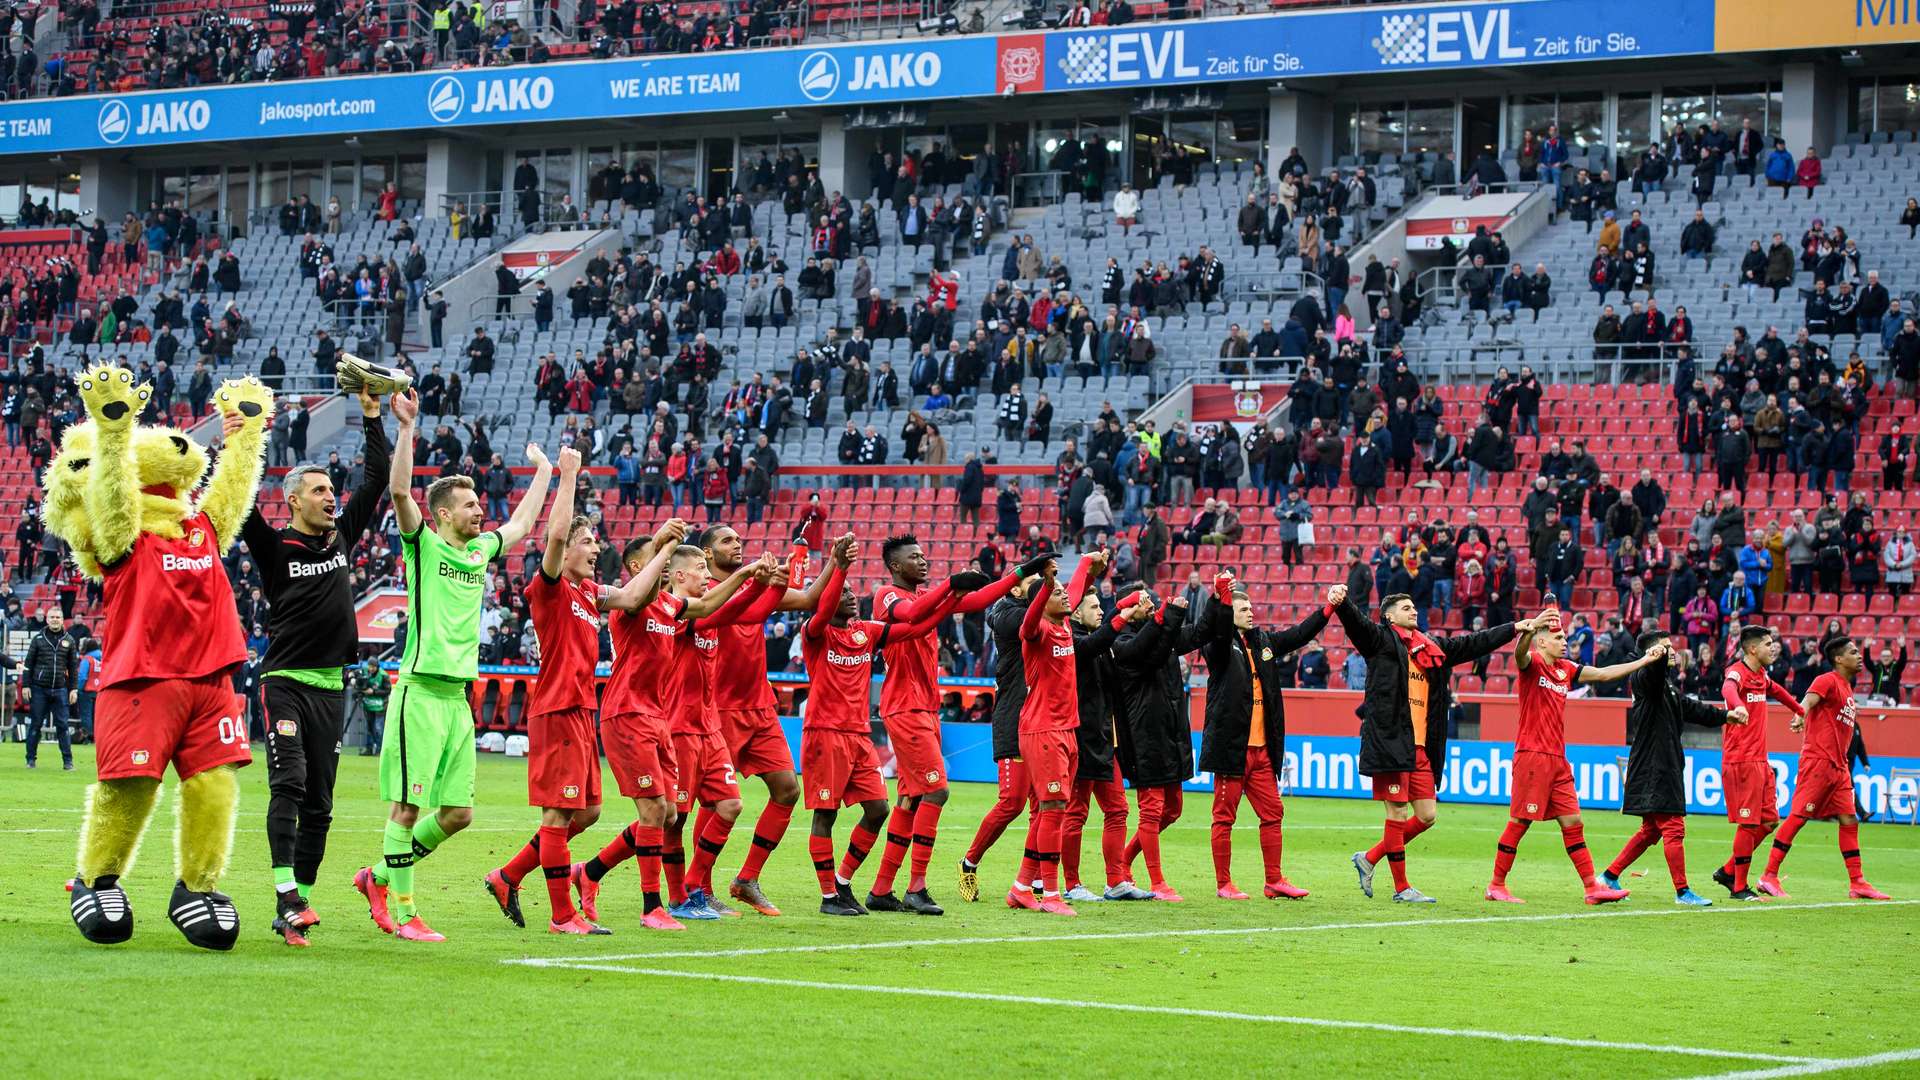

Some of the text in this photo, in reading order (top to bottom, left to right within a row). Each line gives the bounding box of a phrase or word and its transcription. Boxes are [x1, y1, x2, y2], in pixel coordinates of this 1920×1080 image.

[1428, 9, 1526, 62] EVL
[1534, 32, 1641, 57] Zeit für Sie.
[1109, 29, 1200, 81] EVL
[1206, 52, 1304, 76] Zeit für Sie.
[610, 72, 741, 99] WE ARE TEAM
[847, 51, 942, 91] JAKO
[470, 76, 555, 113] JAKO
[136, 100, 211, 135] JAKO
[260, 98, 376, 125] jakosport.com
[9, 118, 51, 137] TEAM
[218, 714, 246, 745] 04
